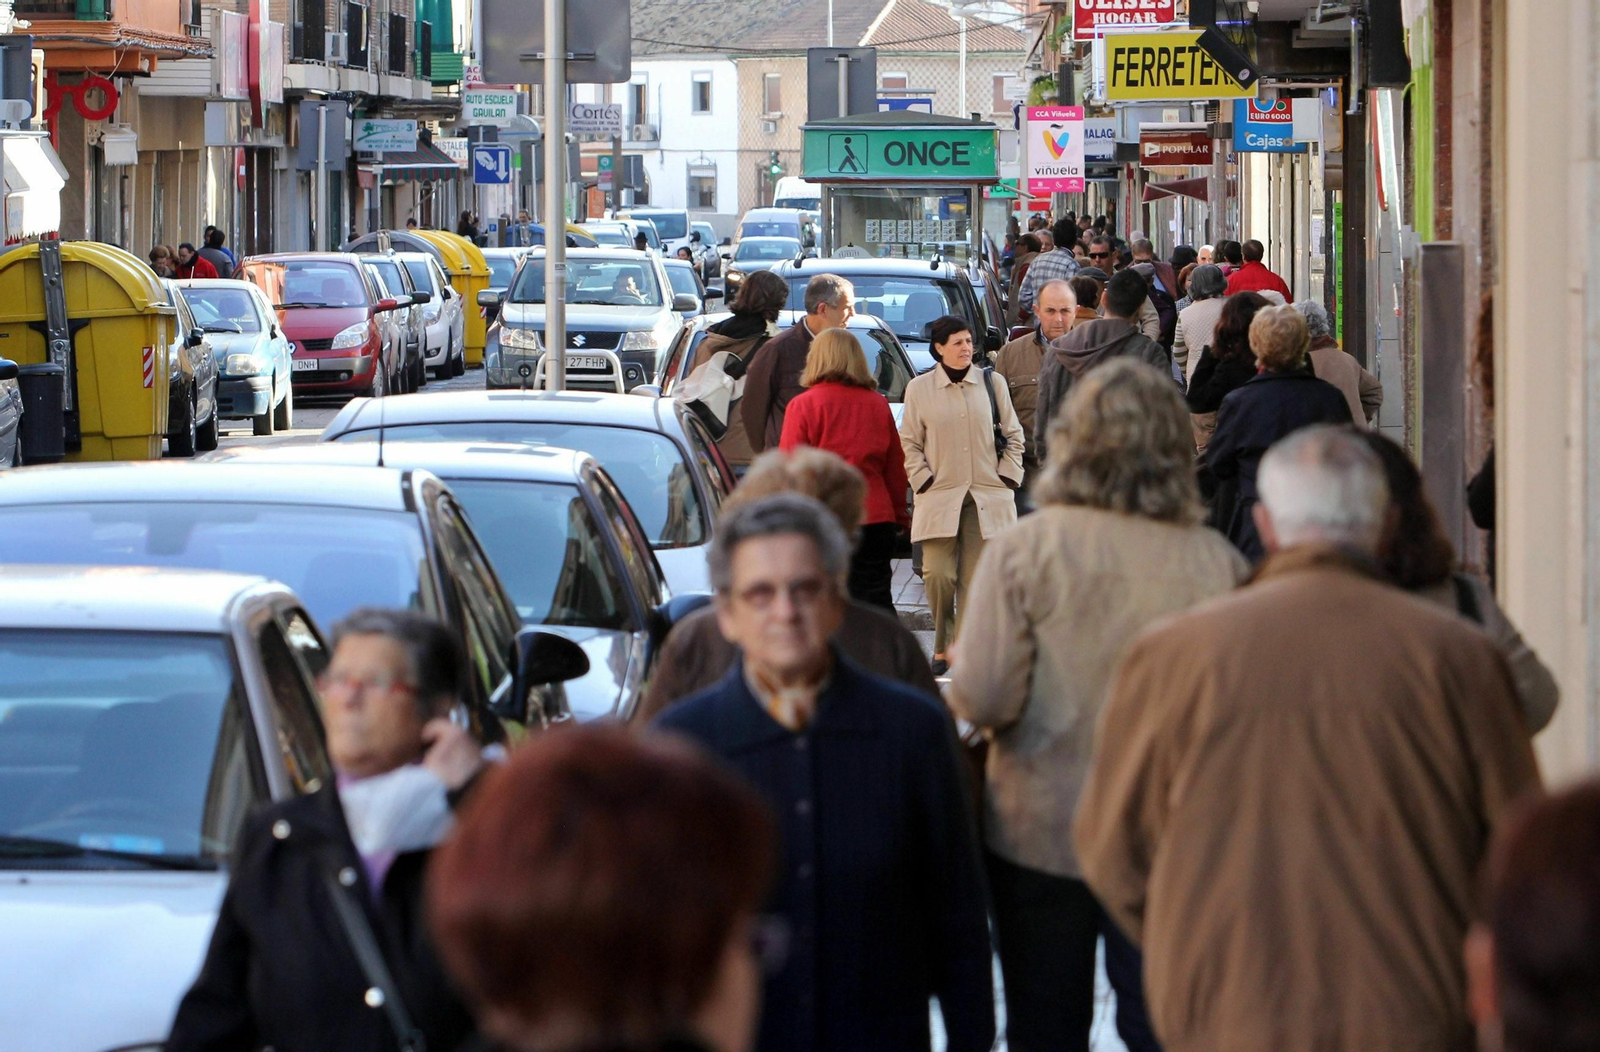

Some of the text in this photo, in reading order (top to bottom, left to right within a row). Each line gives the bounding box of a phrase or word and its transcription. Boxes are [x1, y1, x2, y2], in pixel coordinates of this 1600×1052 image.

[1092, 12, 1158, 24] HOGAR
[466, 94, 513, 104] AUTO ESCUELA
[473, 108, 505, 117] GAVILAN
[572, 104, 620, 119] Cortés
[1246, 133, 1295, 150] Cajaso
[884, 141, 970, 166] ONCE
[1162, 145, 1209, 153] POPULAR
[1034, 165, 1078, 175] viñuela
[298, 360, 315, 370] DNH
[585, 358, 605, 367] FHR
